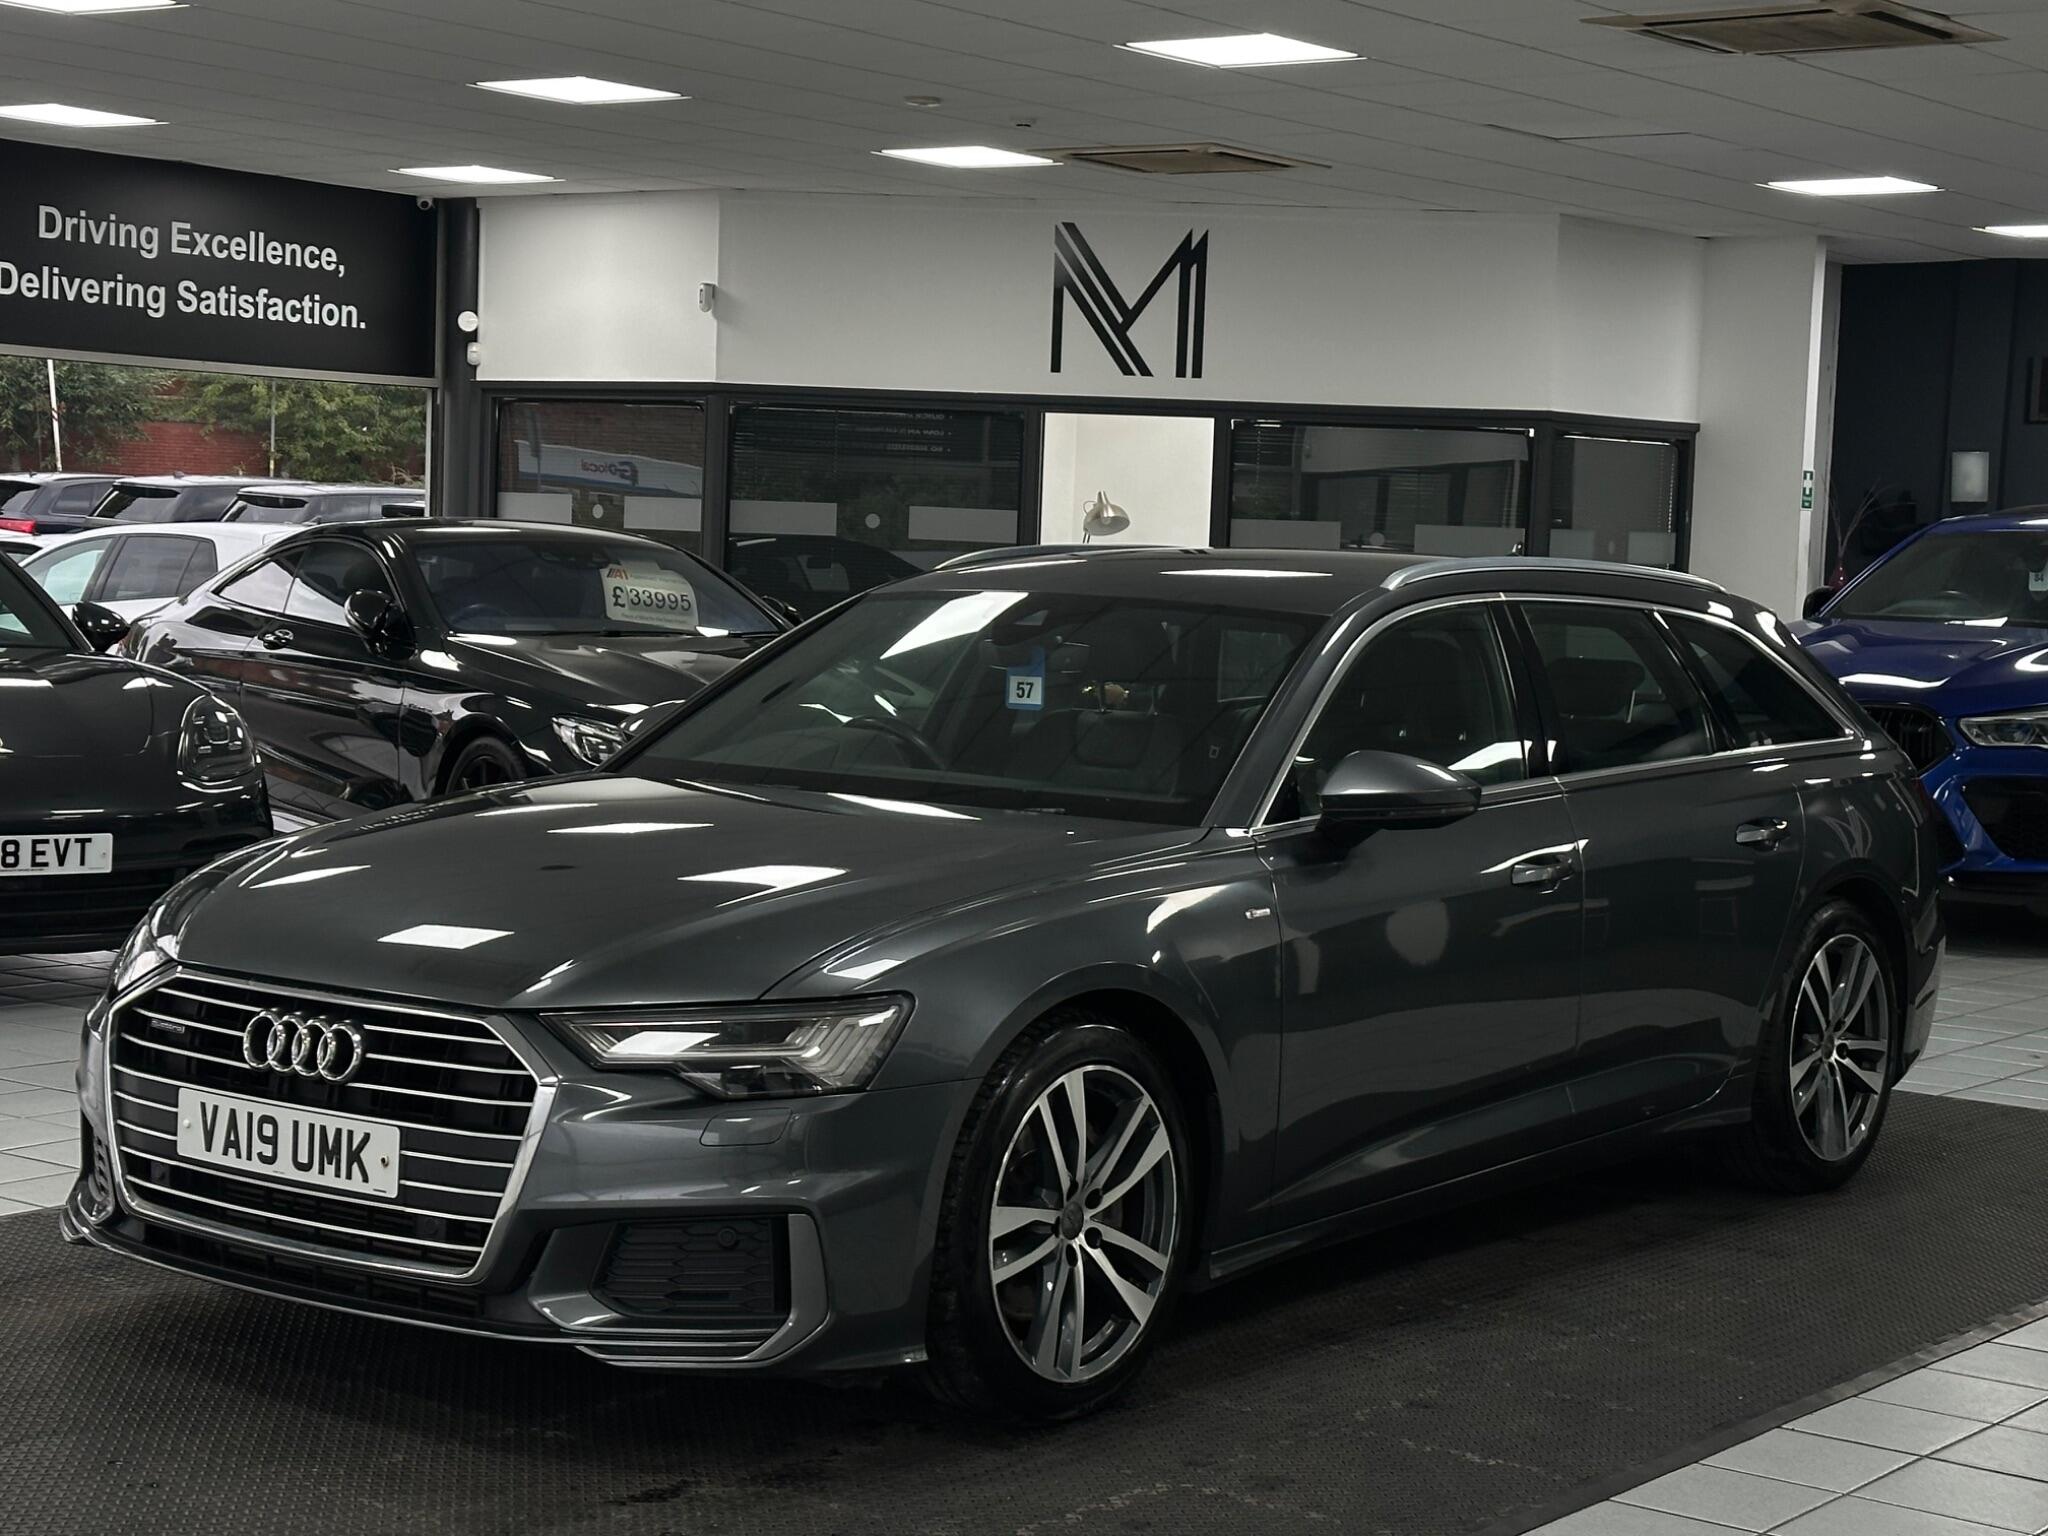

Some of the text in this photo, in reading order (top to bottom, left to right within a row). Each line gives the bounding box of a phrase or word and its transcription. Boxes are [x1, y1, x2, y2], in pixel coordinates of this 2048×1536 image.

[38, 204, 345, 278] Driving Excellence,
[0, 261, 366, 329] Delivering Satisfaction.
[1016, 681, 1034, 699] 57
[31, 838, 92, 868] EVT
[200, 1101, 371, 1184] VA19 UMK
